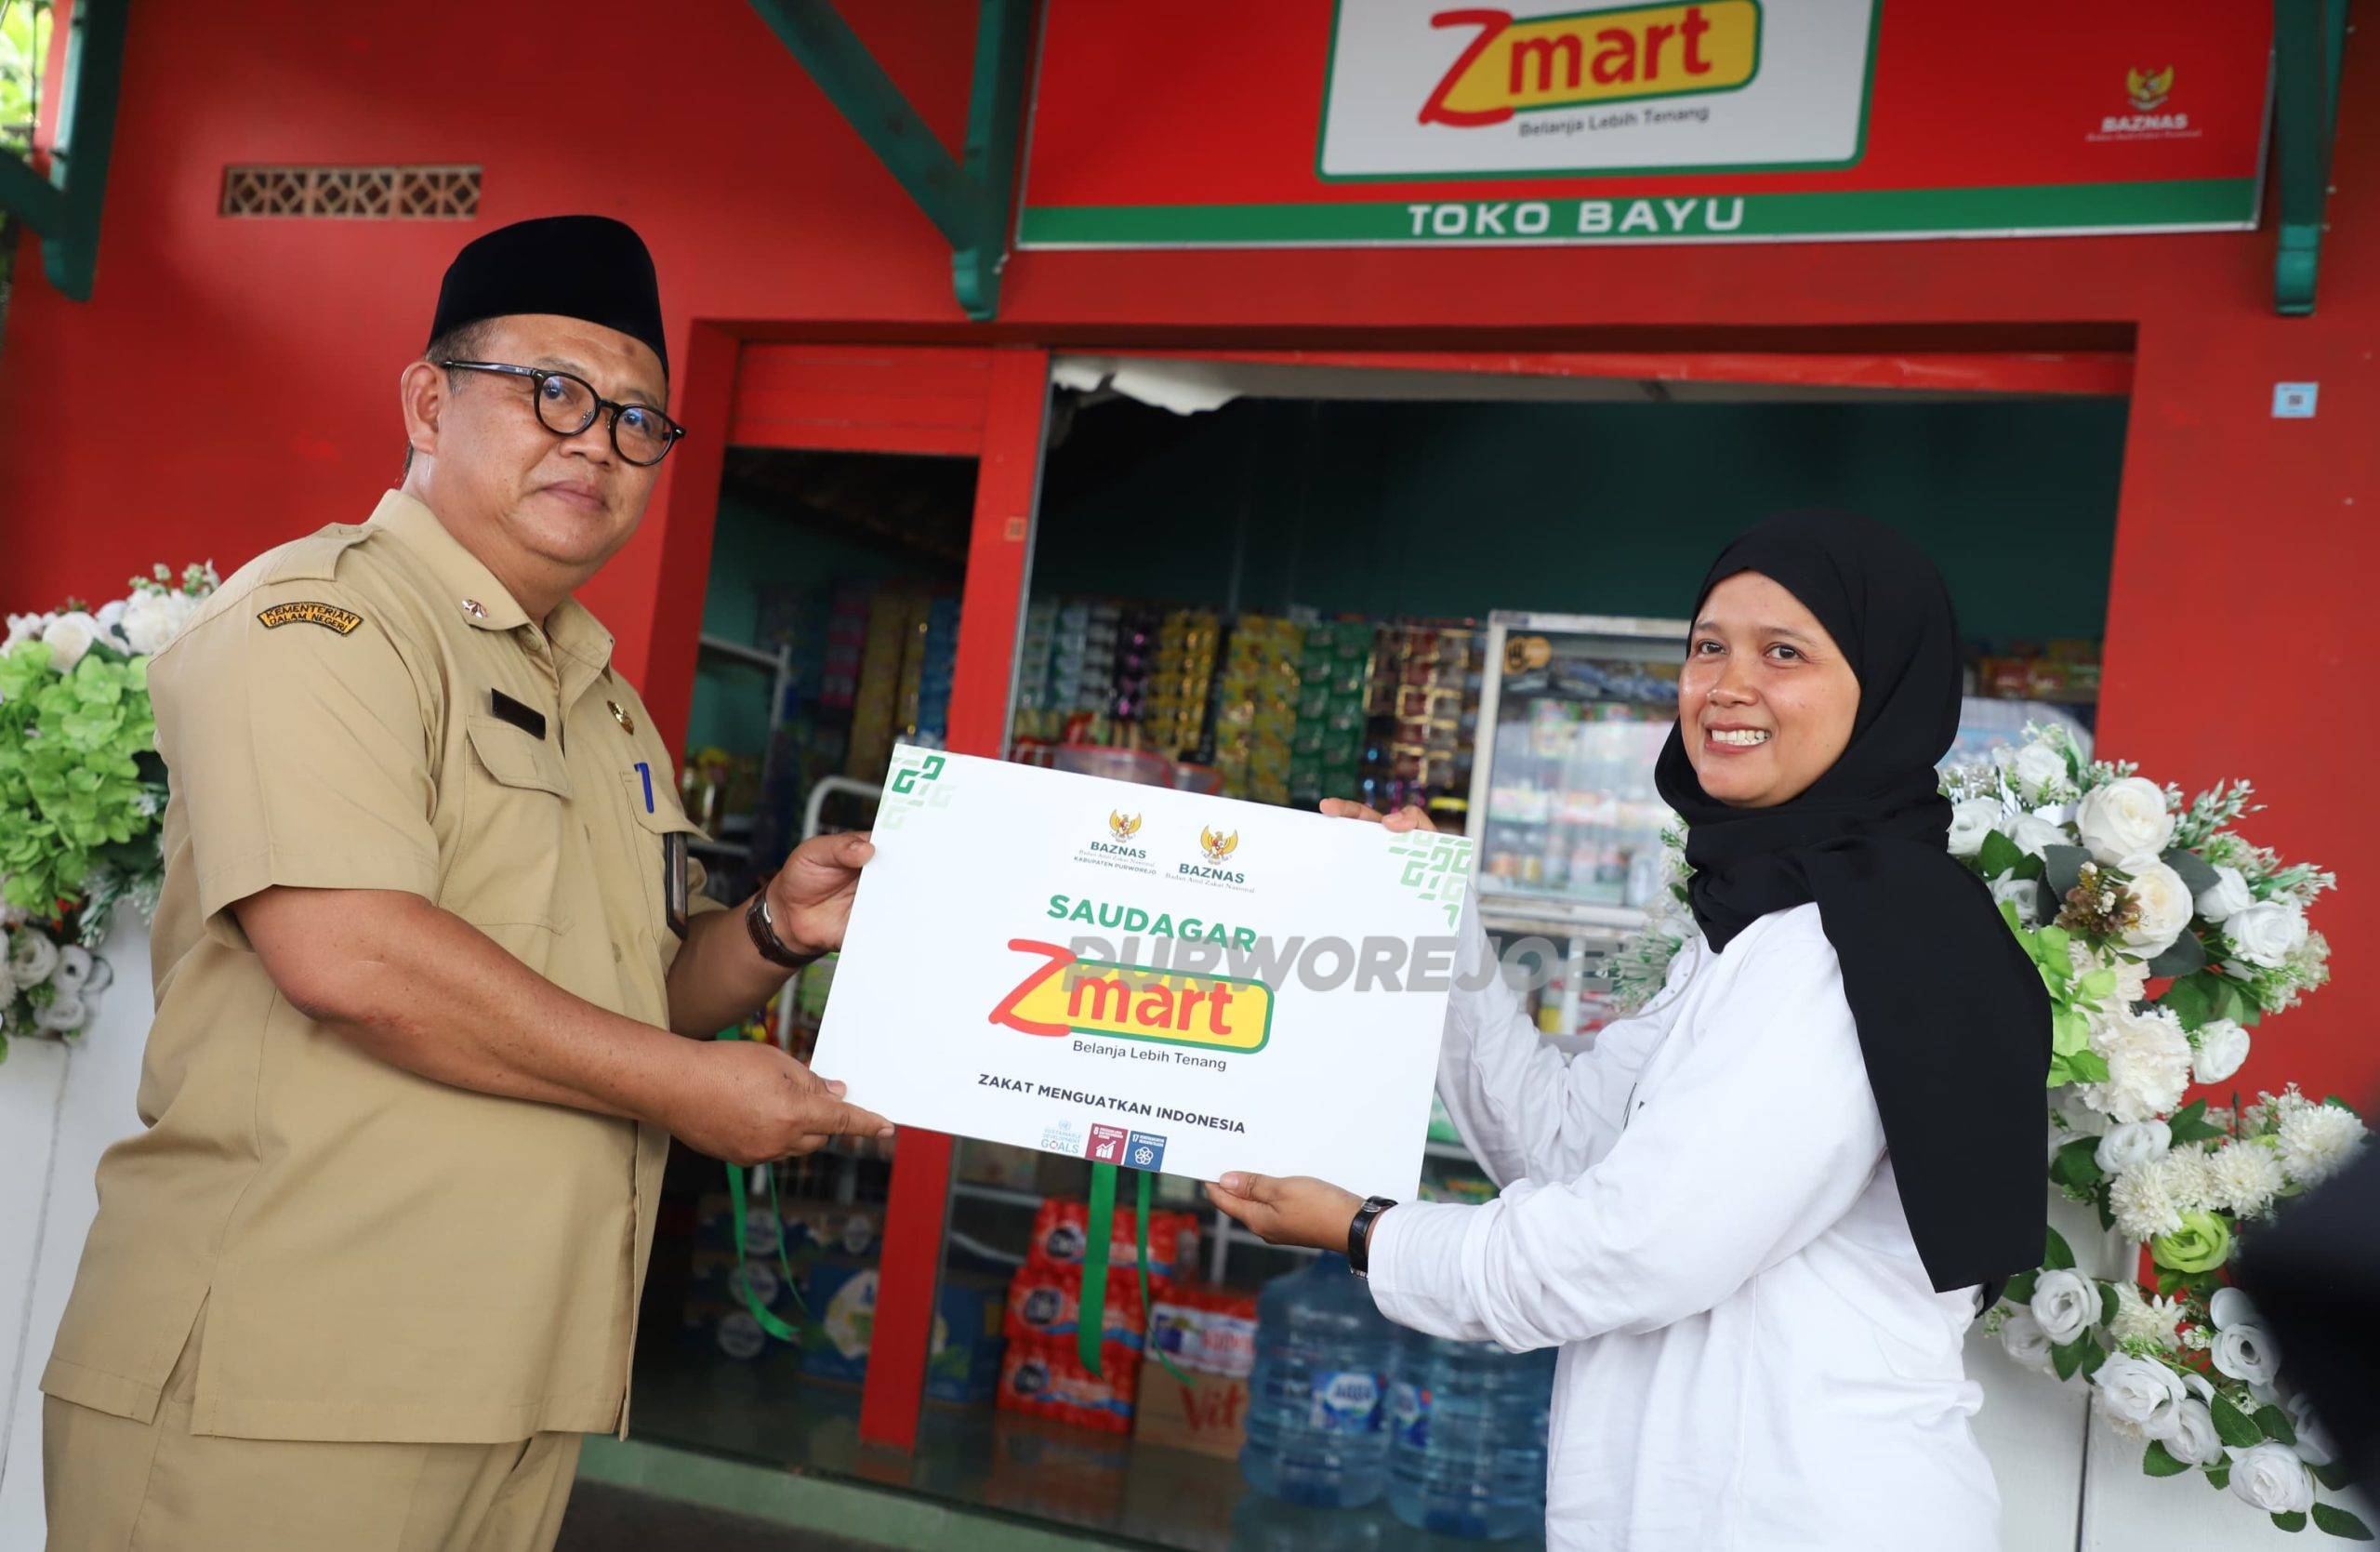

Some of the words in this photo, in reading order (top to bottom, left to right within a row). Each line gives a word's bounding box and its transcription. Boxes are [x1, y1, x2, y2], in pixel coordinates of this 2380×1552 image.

[1418, 6, 1712, 127] Zmart
[1588, 110, 1638, 130] Lebih
[1644, 105, 1710, 126] Tenang
[1407, 204, 1551, 235] TOKO
[1577, 197, 1745, 232] BAYU
[266, 604, 355, 624] KEMENTERIAN
[270, 613, 307, 626] DALAM
[311, 614, 347, 632] NEGERI
[1091, 841, 1147, 859] BAZNAS
[1074, 856, 1113, 867] KABUPATEN
[1115, 863, 1157, 875] PURWOREJO
[1179, 863, 1245, 884] BAZNAS
[1047, 894, 1256, 953] SAUDAGAR
[988, 938, 1234, 1037] Zmart
[1073, 1040, 1126, 1058] Belanja
[1130, 1047, 1170, 1064] Lebih
[1174, 1053, 1226, 1071] Tenang
[978, 1073, 1034, 1094] ZAKAT
[1038, 1084, 1153, 1117] MENGUATKAN
[1156, 1107, 1246, 1134] INDONESIA
[1040, 1138, 1080, 1154] GOALS
